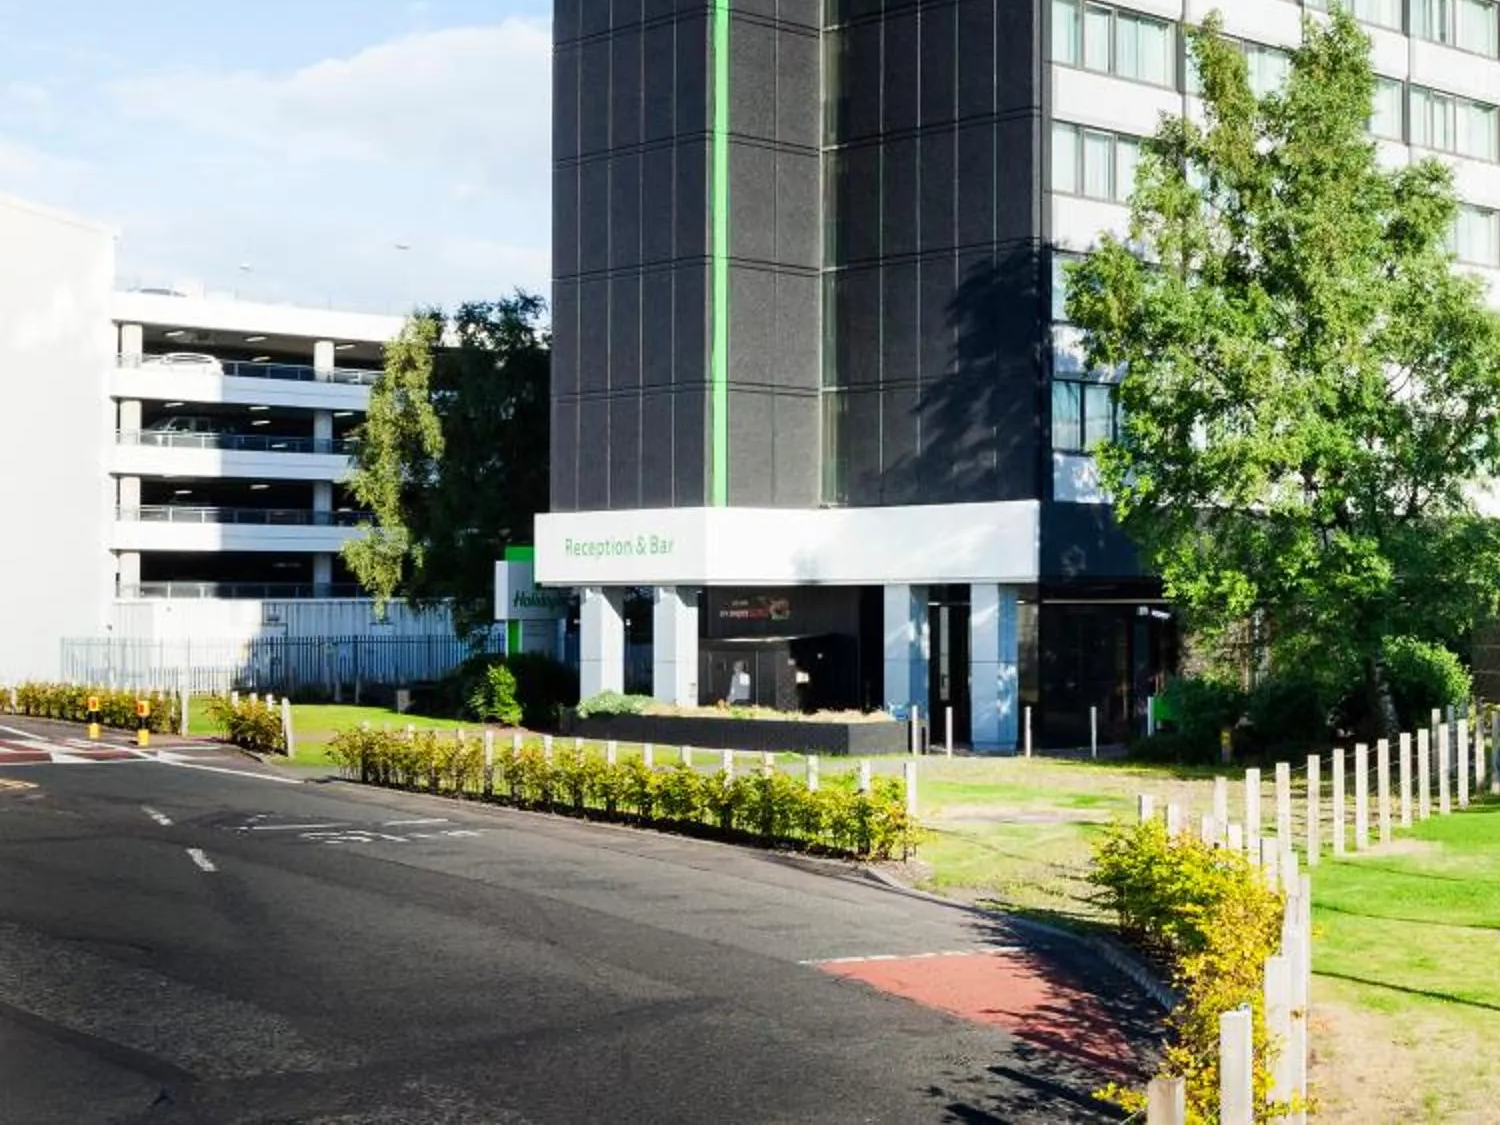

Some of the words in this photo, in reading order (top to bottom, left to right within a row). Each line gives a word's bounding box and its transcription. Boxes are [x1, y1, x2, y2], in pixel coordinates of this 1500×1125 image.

[564, 536, 634, 561] Reception
[636, 534, 647, 556] &
[650, 533, 675, 555] Bar
